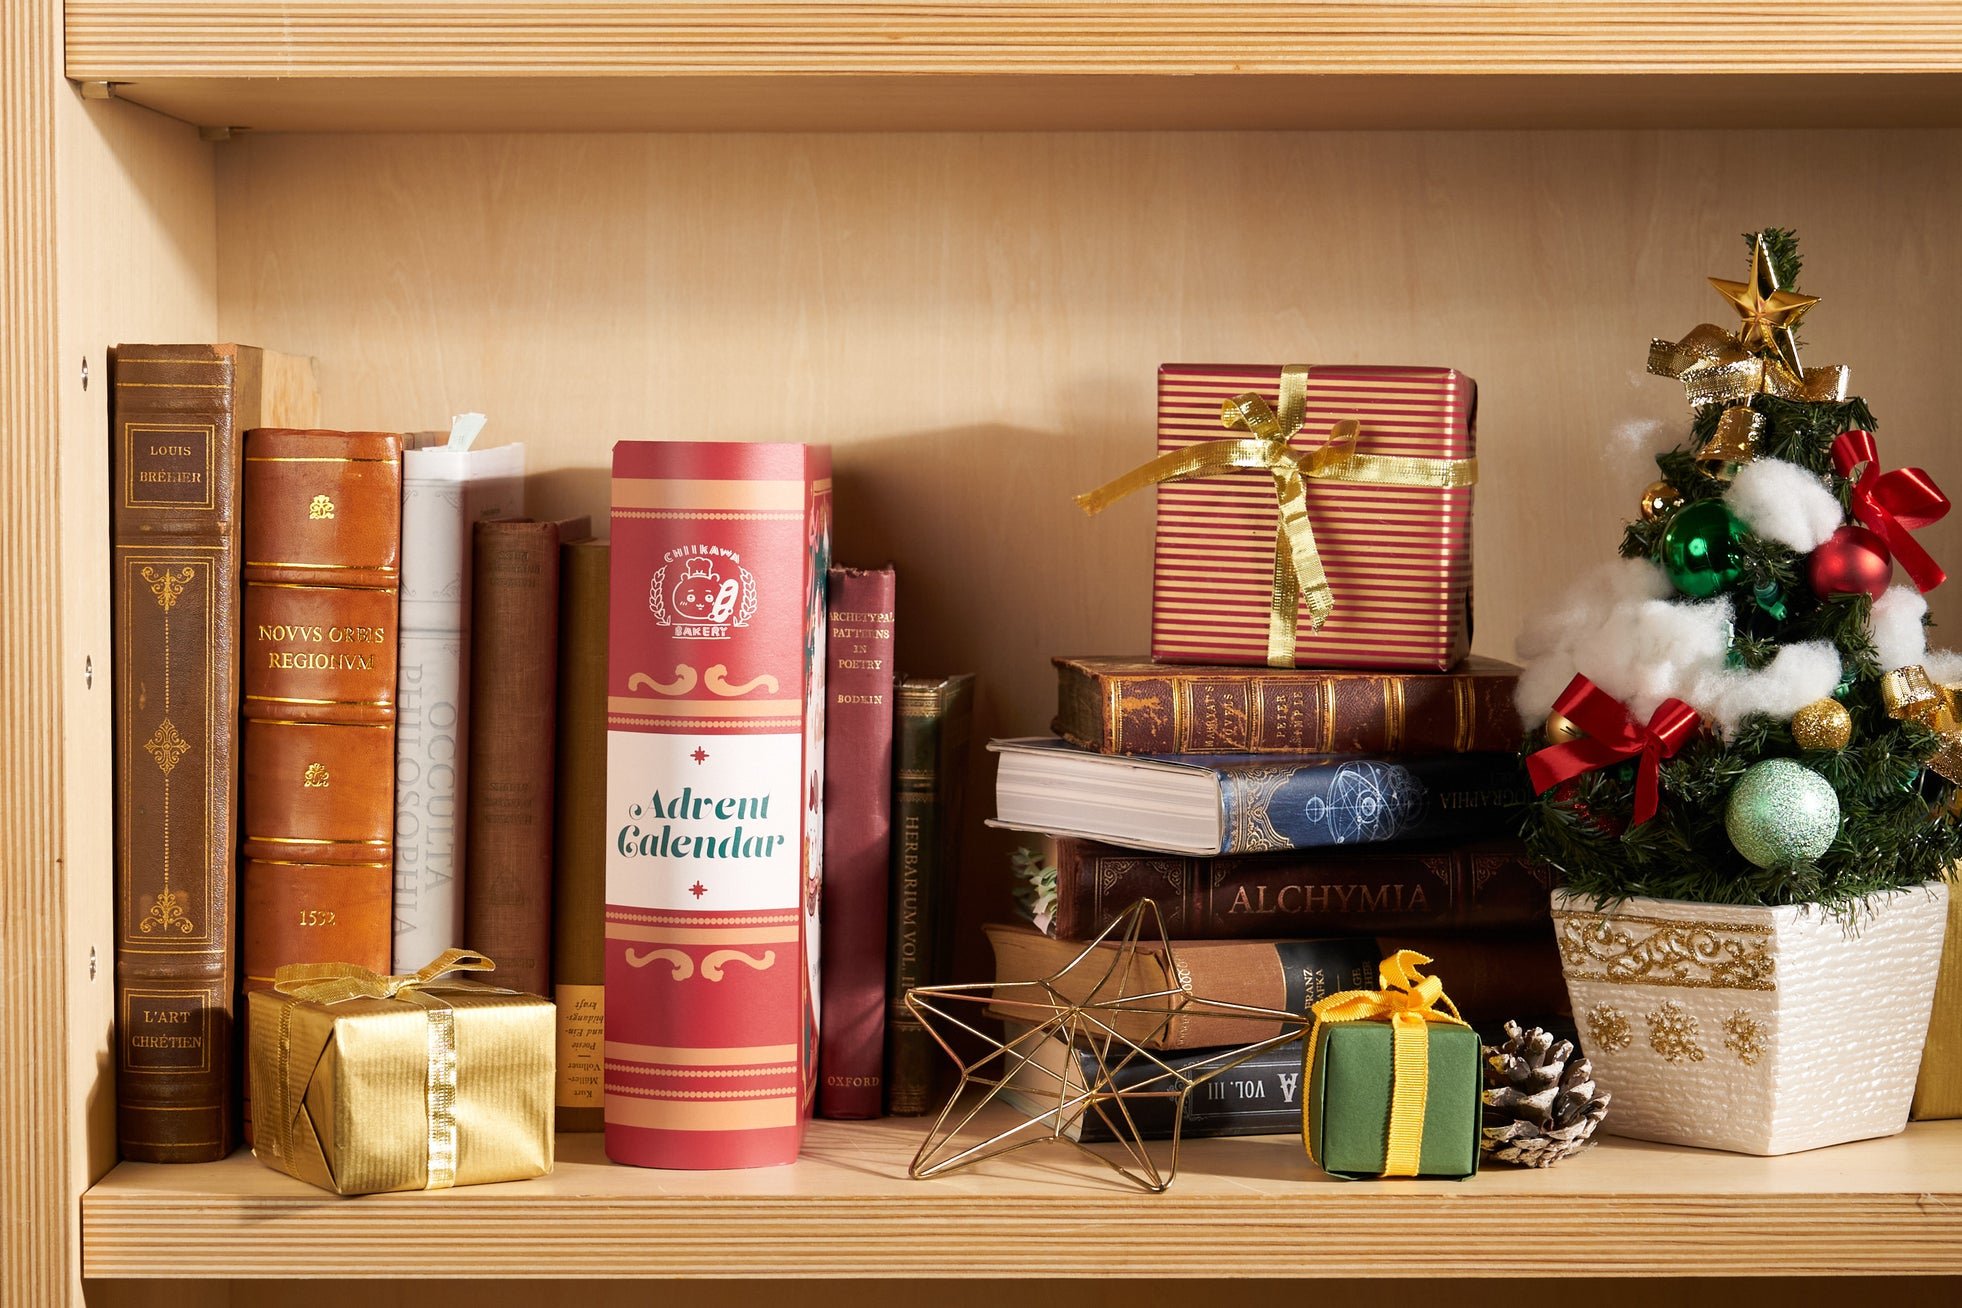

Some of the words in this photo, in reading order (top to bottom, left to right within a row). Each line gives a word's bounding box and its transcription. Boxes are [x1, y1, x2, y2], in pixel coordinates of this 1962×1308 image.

[150, 446, 192, 456] LOUIS
[664, 544, 740, 564] CHIIKAWA
[829, 612, 894, 623] ARCHETYPAL
[258, 625, 322, 642] NOVVS
[328, 626, 385, 643] ORBIS
[674, 625, 728, 637] BAKERY
[833, 628, 890, 639] PATTERNS
[853, 645, 867, 654] IN
[268, 652, 375, 670] REGIONVM
[838, 659, 882, 670] POETRY
[837, 694, 883, 705] BODKIN
[1276, 694, 1287, 738] PETER
[395, 664, 423, 937] PHILOSOPHIA
[425, 701, 457, 893] OCCULTA
[628, 787, 770, 820] Advent
[617, 825, 785, 859] Calendar
[902, 816, 919, 926] HERBARIUM
[1229, 884, 1431, 913] ALCHYMIA
[300, 910, 336, 926] 1532
[1303, 966, 1314, 1009] FRANZ
[1316, 968, 1325, 999] AFKA
[575, 999, 598, 1011] kraft
[144, 1010, 190, 1023] L'ART
[586, 1028, 603, 1036] und
[132, 1033, 202, 1049] CHRÉTIEN
[568, 1062, 601, 1072] Vollmer
[827, 1076, 880, 1087] OXFORD
[1230, 1080, 1266, 1098] VOL.
[574, 1090, 593, 1098] Kurt
[1207, 1081, 1225, 1100] III
